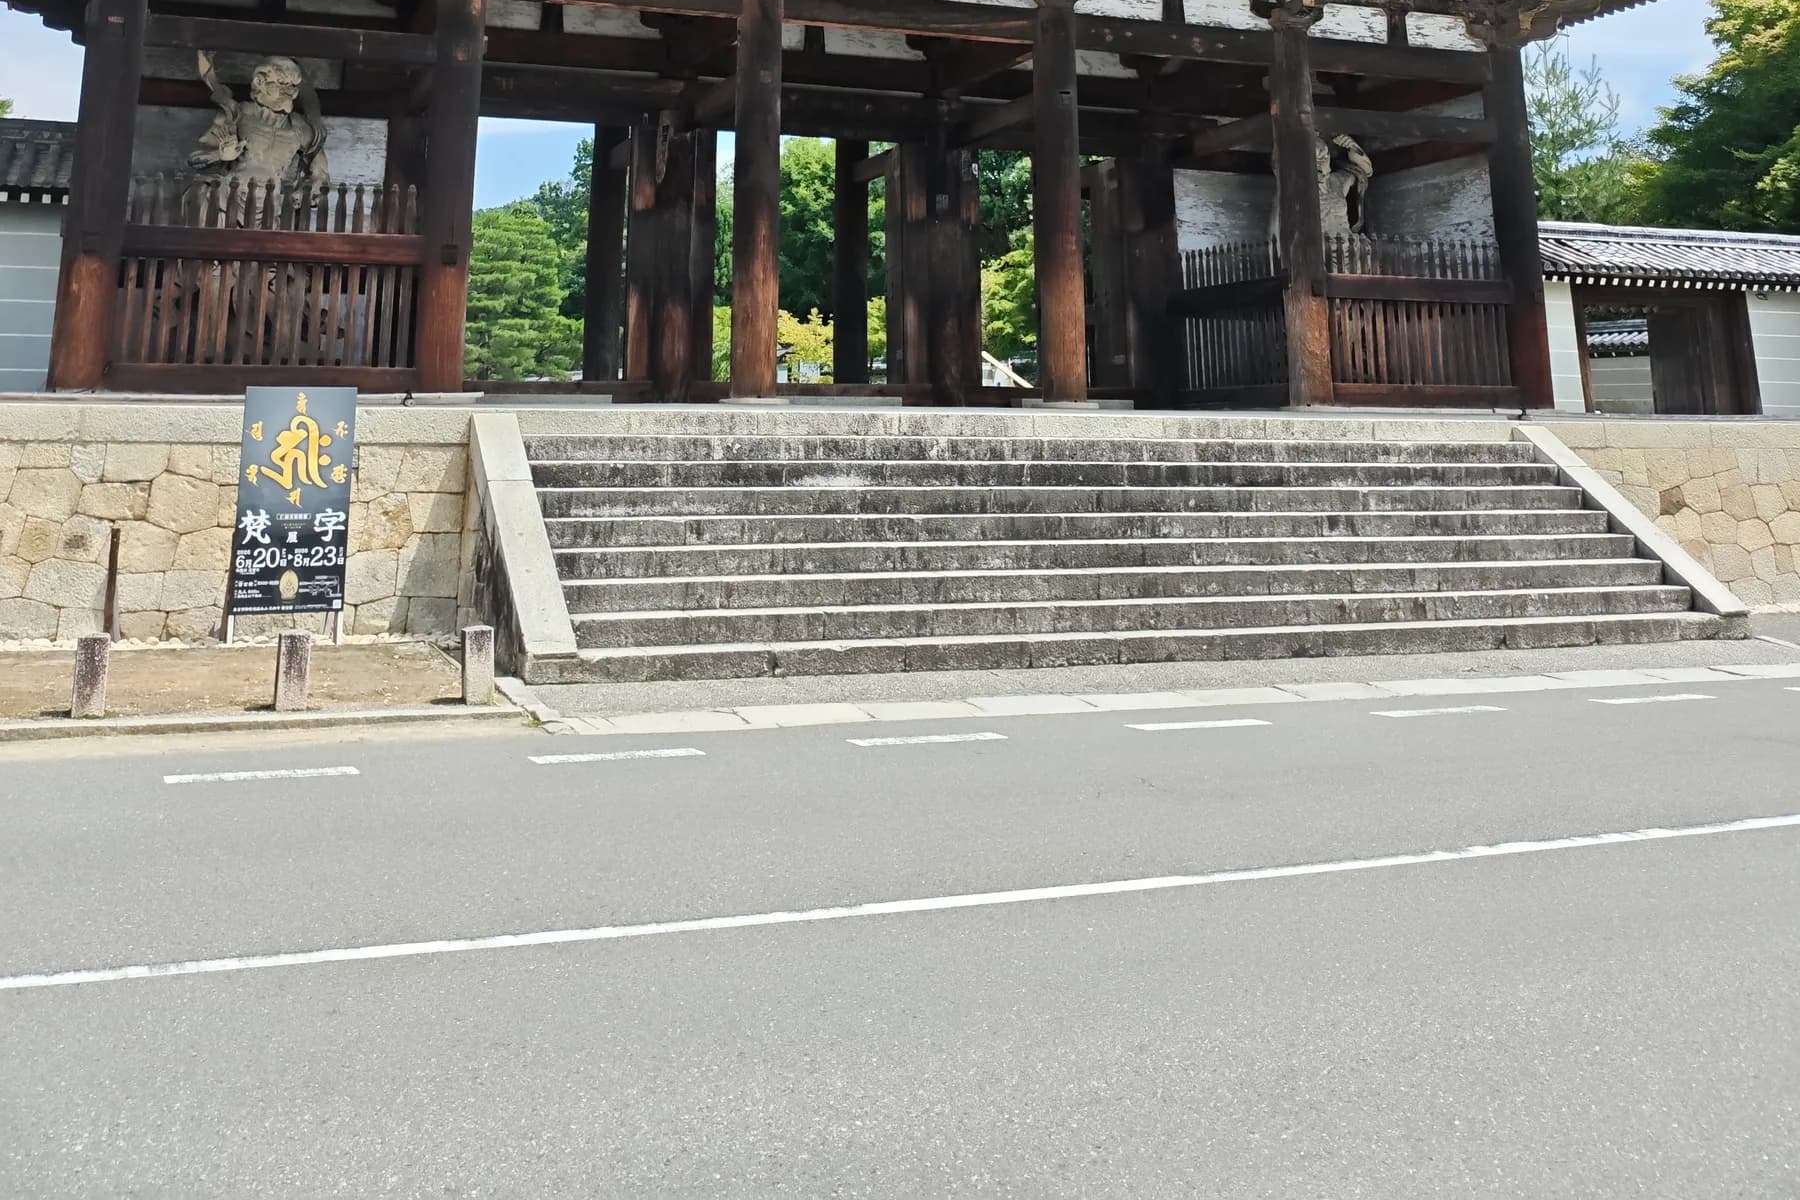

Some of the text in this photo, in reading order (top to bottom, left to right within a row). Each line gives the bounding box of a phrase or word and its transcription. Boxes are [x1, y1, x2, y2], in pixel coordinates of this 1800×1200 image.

[238, 509, 272, 545] 梵
[286, 531, 298, 543] 展
[313, 508, 346, 542] 字
[293, 546, 344, 568] 8月23日
